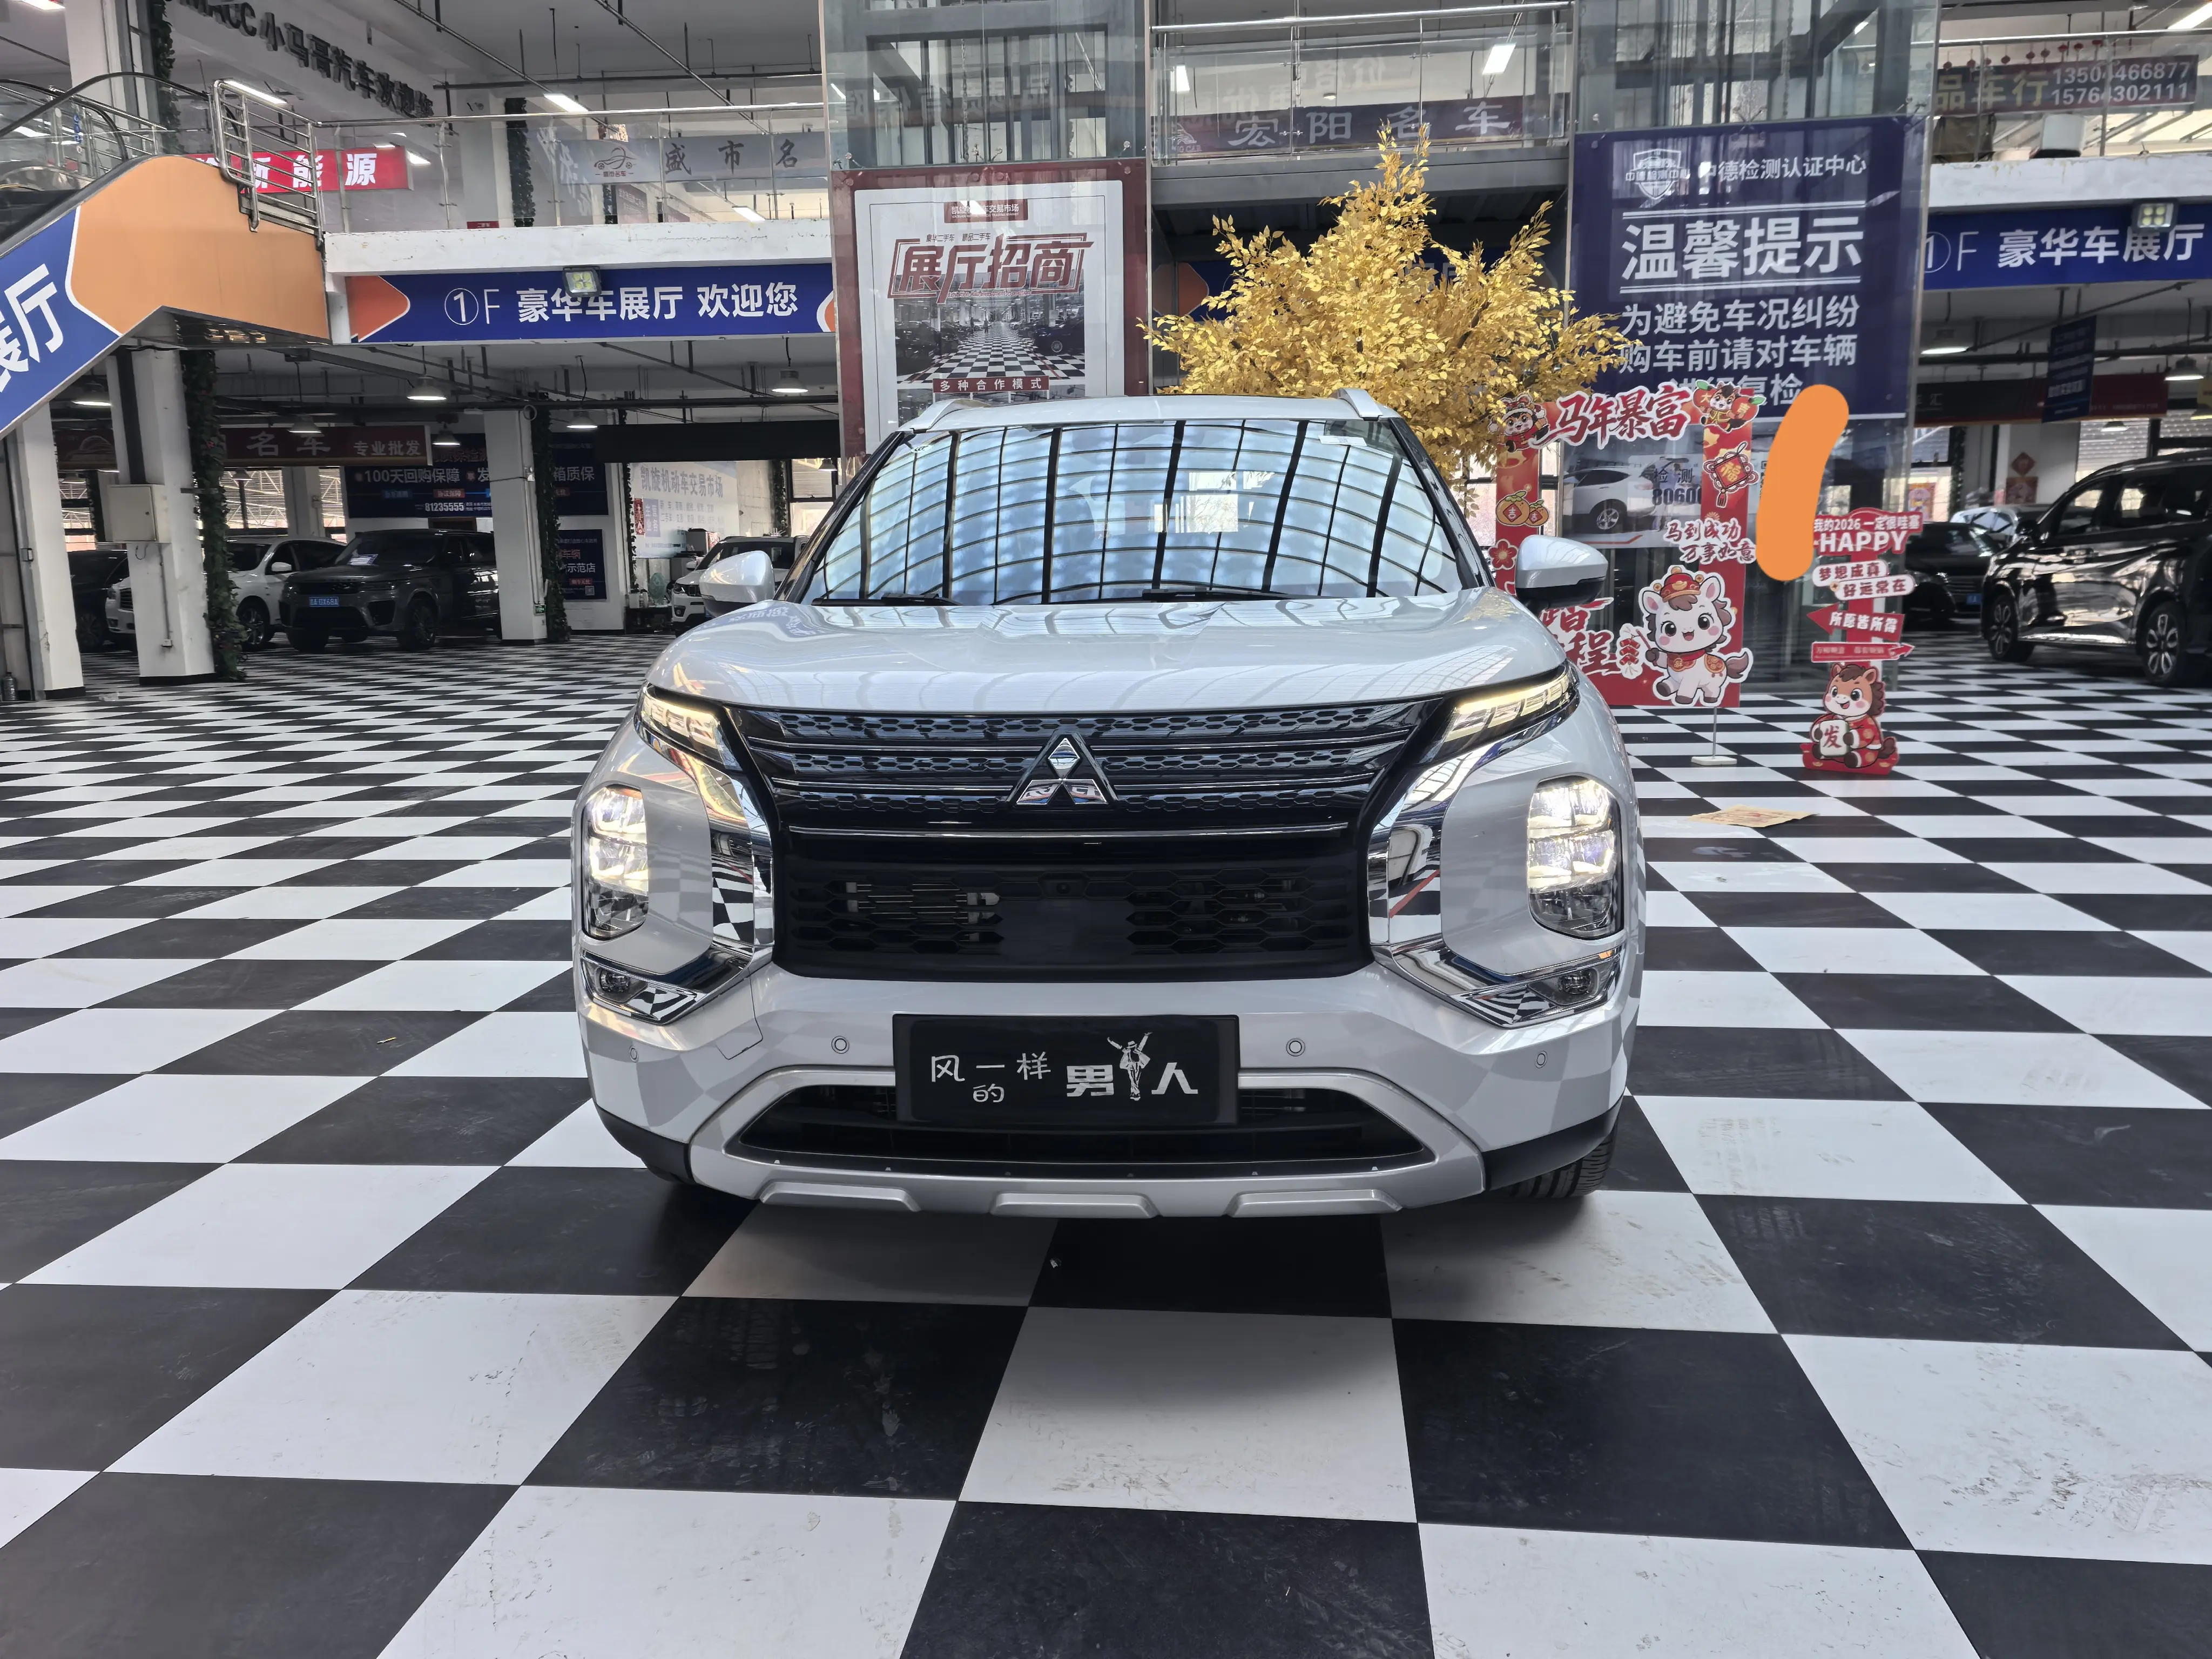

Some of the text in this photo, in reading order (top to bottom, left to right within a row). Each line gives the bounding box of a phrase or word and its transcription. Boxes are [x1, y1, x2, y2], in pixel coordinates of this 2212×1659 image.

[1228, 102, 1510, 147] 宏阳名车
[1698, 154, 1867, 182] 中德检测认证中心
[1622, 217, 1863, 280] 温馨提示
[1998, 224, 2205, 268] 豪华车展厅
[899, 234, 1095, 304] 展厅招商
[517, 284, 683, 323] 豪华车展厅
[697, 282, 798, 319] 欢迎您
[1621, 295, 1859, 336] 为避免车况纠纷
[1618, 334, 1857, 374] 购车前请对车辆
[940, 377, 1041, 392] 多种合作模式
[1530, 383, 1690, 447] 马年暴富
[219, 429, 331, 457] 名车
[354, 440, 421, 456] 专业批发
[365, 468, 460, 483] 100天回购保障
[640, 466, 723, 498] 凯旋机动车交易市场
[1654, 468, 1693, 483] 检测
[424, 502, 464, 511] 81235555
[1666, 521, 1741, 541] 马到成功
[1820, 530, 1908, 552] HAPPY
[1681, 542, 1755, 562] 万事如意
[564, 563, 596, 573] 示范店
[1819, 563, 1880, 582] 梦想成真
[1843, 578, 1906, 598] 好运常在
[1823, 725, 1842, 748] 发
[932, 1052, 1051, 1082] 风一样
[1067, 1062, 1198, 1097] 男人
[973, 1083, 1004, 1103] 的
